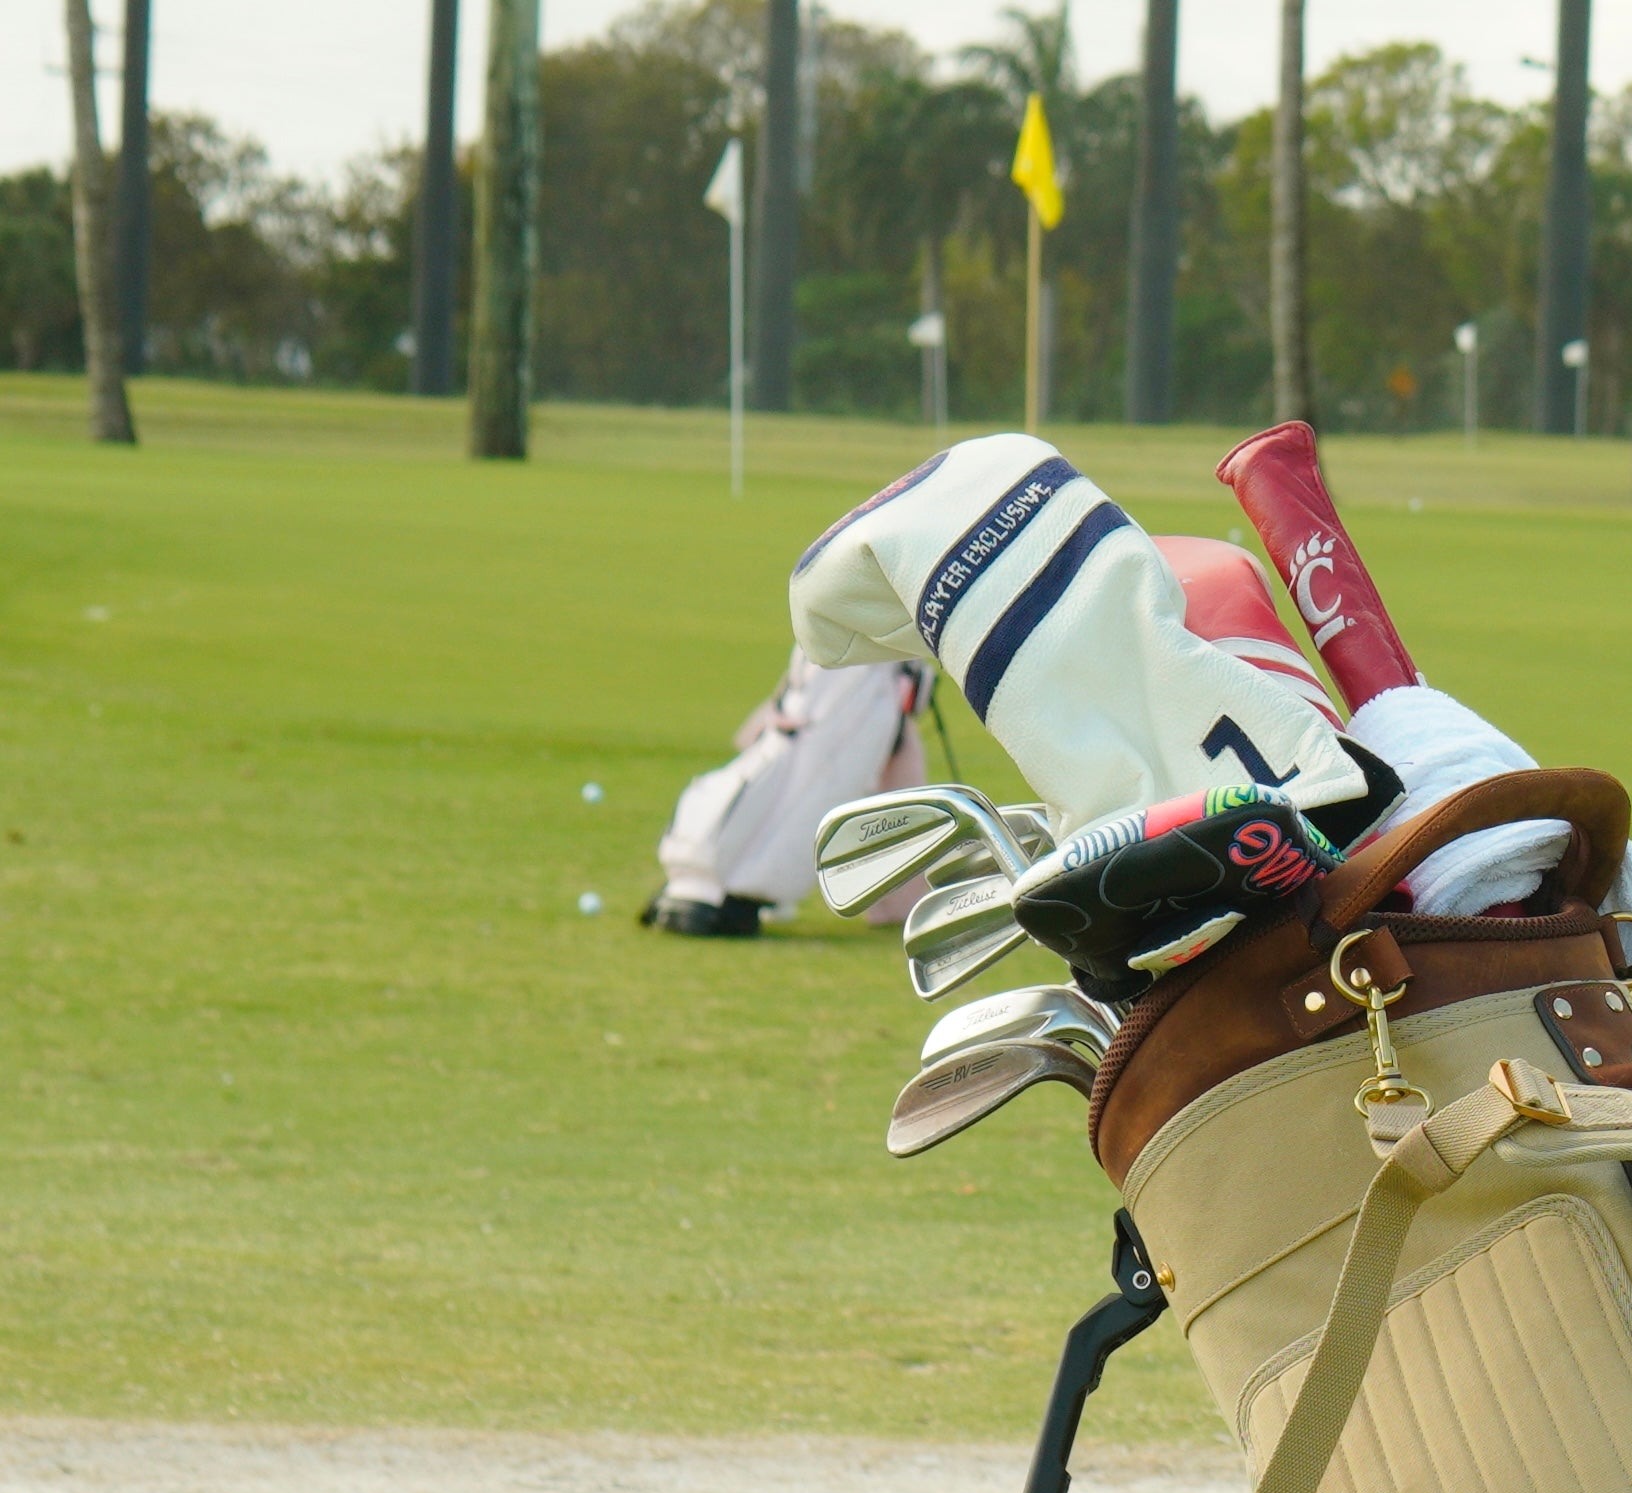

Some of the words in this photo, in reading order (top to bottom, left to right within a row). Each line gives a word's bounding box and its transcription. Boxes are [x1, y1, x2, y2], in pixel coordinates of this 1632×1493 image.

[921, 560, 971, 648] PLAYER
[961, 481, 1051, 566] EXCLUSIVE
[1201, 714, 1300, 787] 1
[859, 814, 911, 842] Titleist
[947, 889, 998, 916] Titleist
